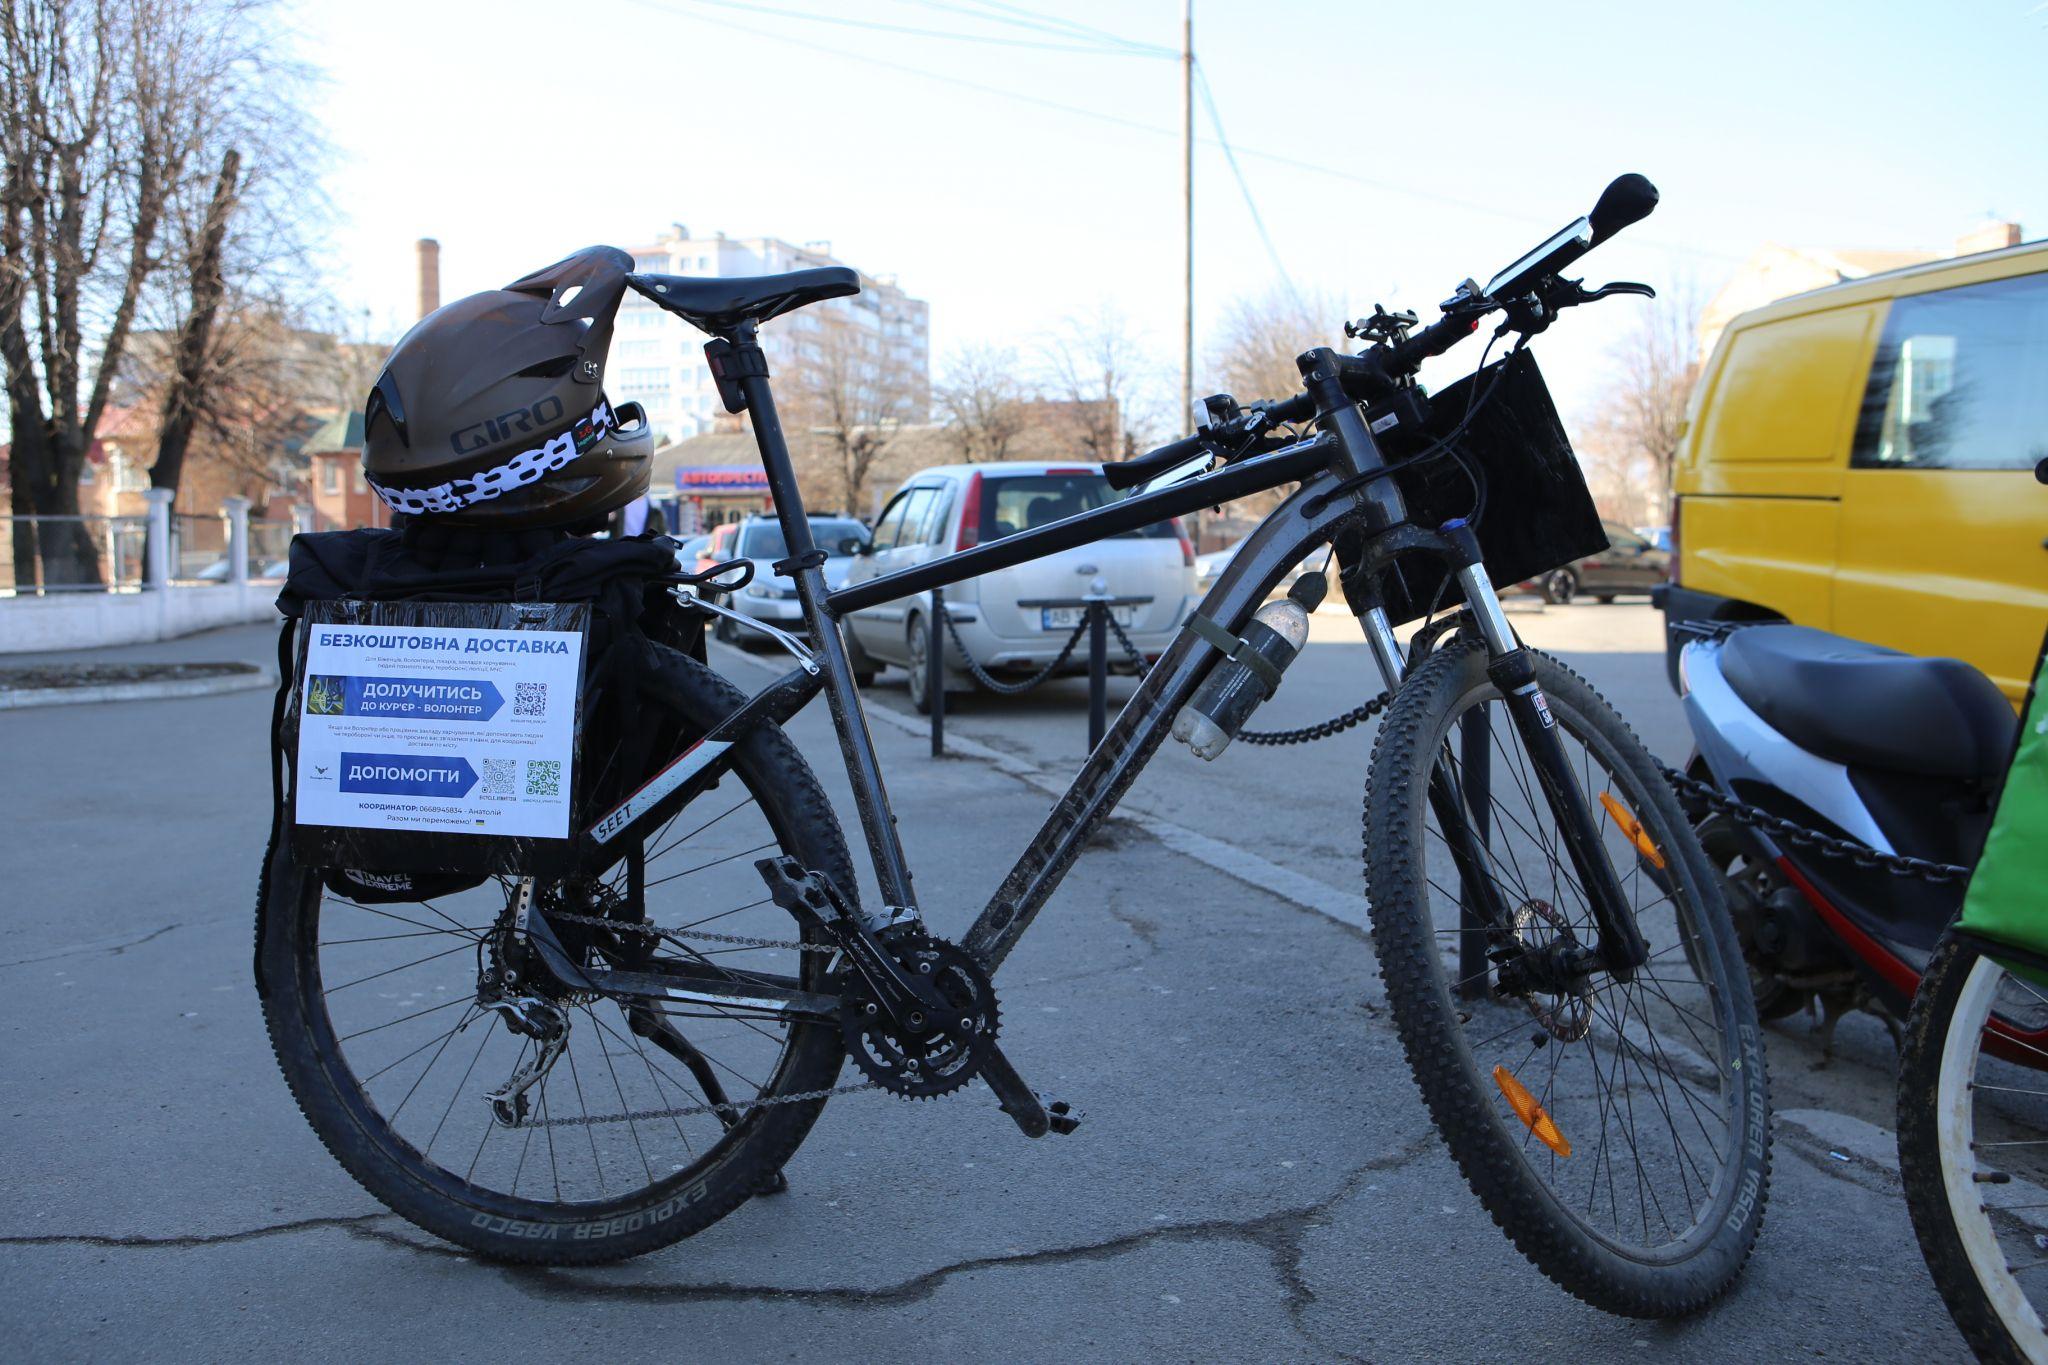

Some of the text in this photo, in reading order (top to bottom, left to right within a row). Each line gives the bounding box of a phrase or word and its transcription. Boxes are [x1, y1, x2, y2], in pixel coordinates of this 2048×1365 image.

[450, 395, 564, 455] GIRO
[320, 633, 569, 655] БЕЗКОШТОВНА ДОСТАВКА
[363, 683, 482, 701] ДОЛУЧИТИСЬ
[361, 702, 377, 711] ДО
[380, 703, 415, 712] КУР'ЄР
[424, 704, 482, 714] ВОЛОНТЕР
[348, 765, 460, 783] ДОПОМОГТИ
[359, 803, 418, 812] КООРДИНАТОР:
[419, 805, 463, 814] 0668945834
[469, 807, 502, 816] Анатолій
[387, 814, 409, 822] Разом
[421, 816, 472, 825] переможемо!
[598, 803, 632, 839] SEET
[363, 871, 412, 882] TRAVEL
[365, 880, 413, 891] EXTREME
[1726, 1023, 1765, 1232] EXPLORER VASCO
[471, 1180, 708, 1240] EXPLORER VASCO
